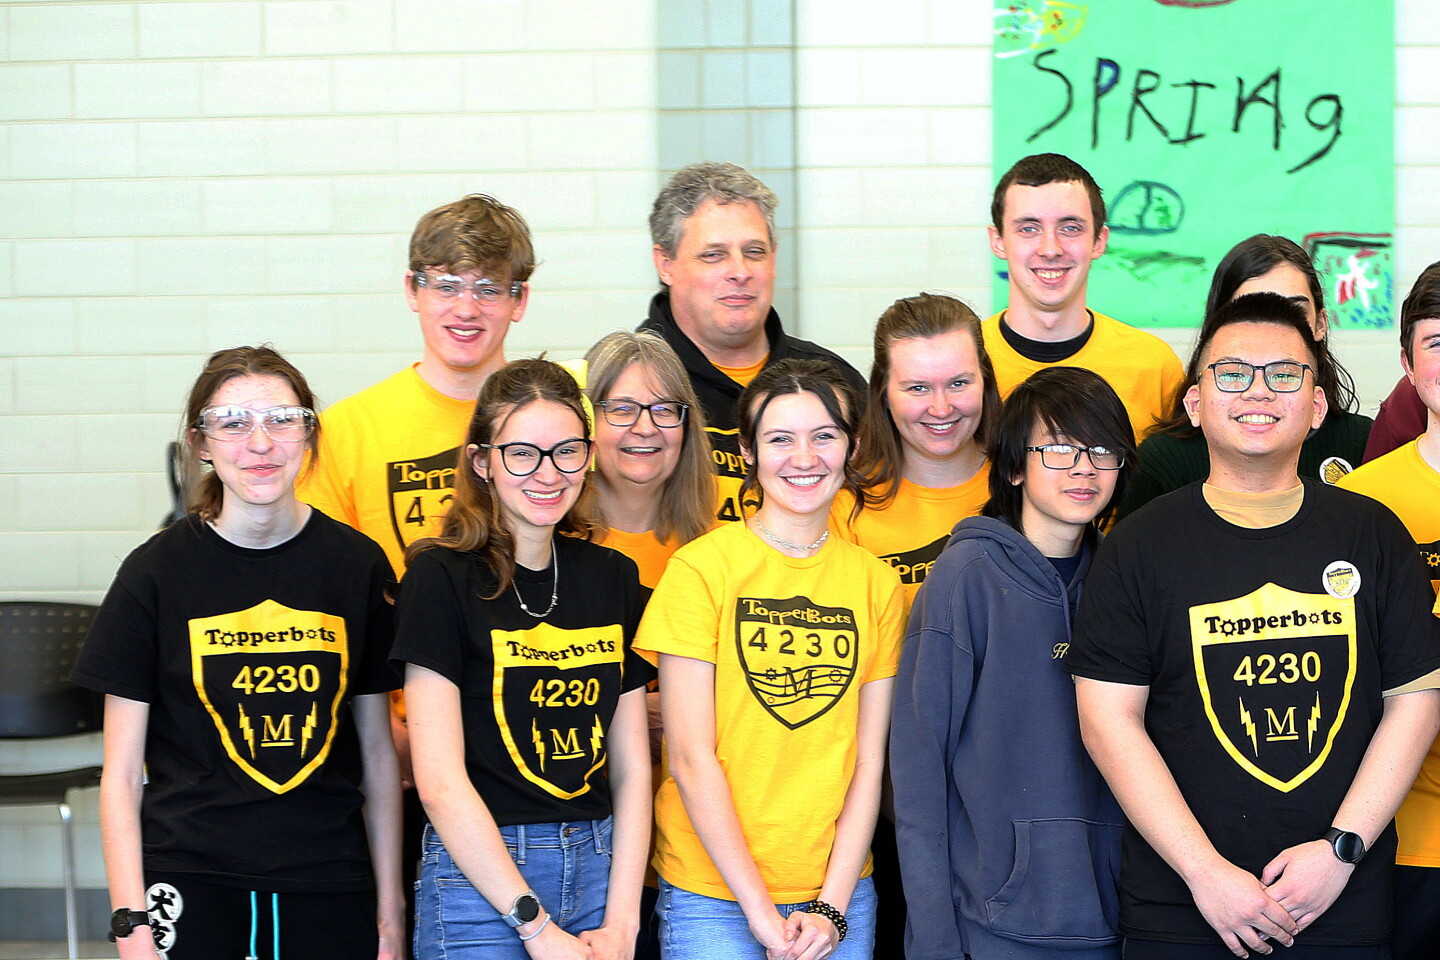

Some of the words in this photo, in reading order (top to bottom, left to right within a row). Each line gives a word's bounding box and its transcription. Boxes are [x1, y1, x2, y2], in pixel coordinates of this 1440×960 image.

[204, 626, 337, 648] Topperbots
[1204, 609, 1343, 637] Topperbots
[748, 627, 850, 659] 4230
[231, 664, 320, 695] 4230
[1233, 651, 1322, 687] 4230
[529, 678, 600, 708] 4230
[260, 713, 295, 742] M
[1264, 706, 1299, 736] M
[549, 727, 585, 755] M
